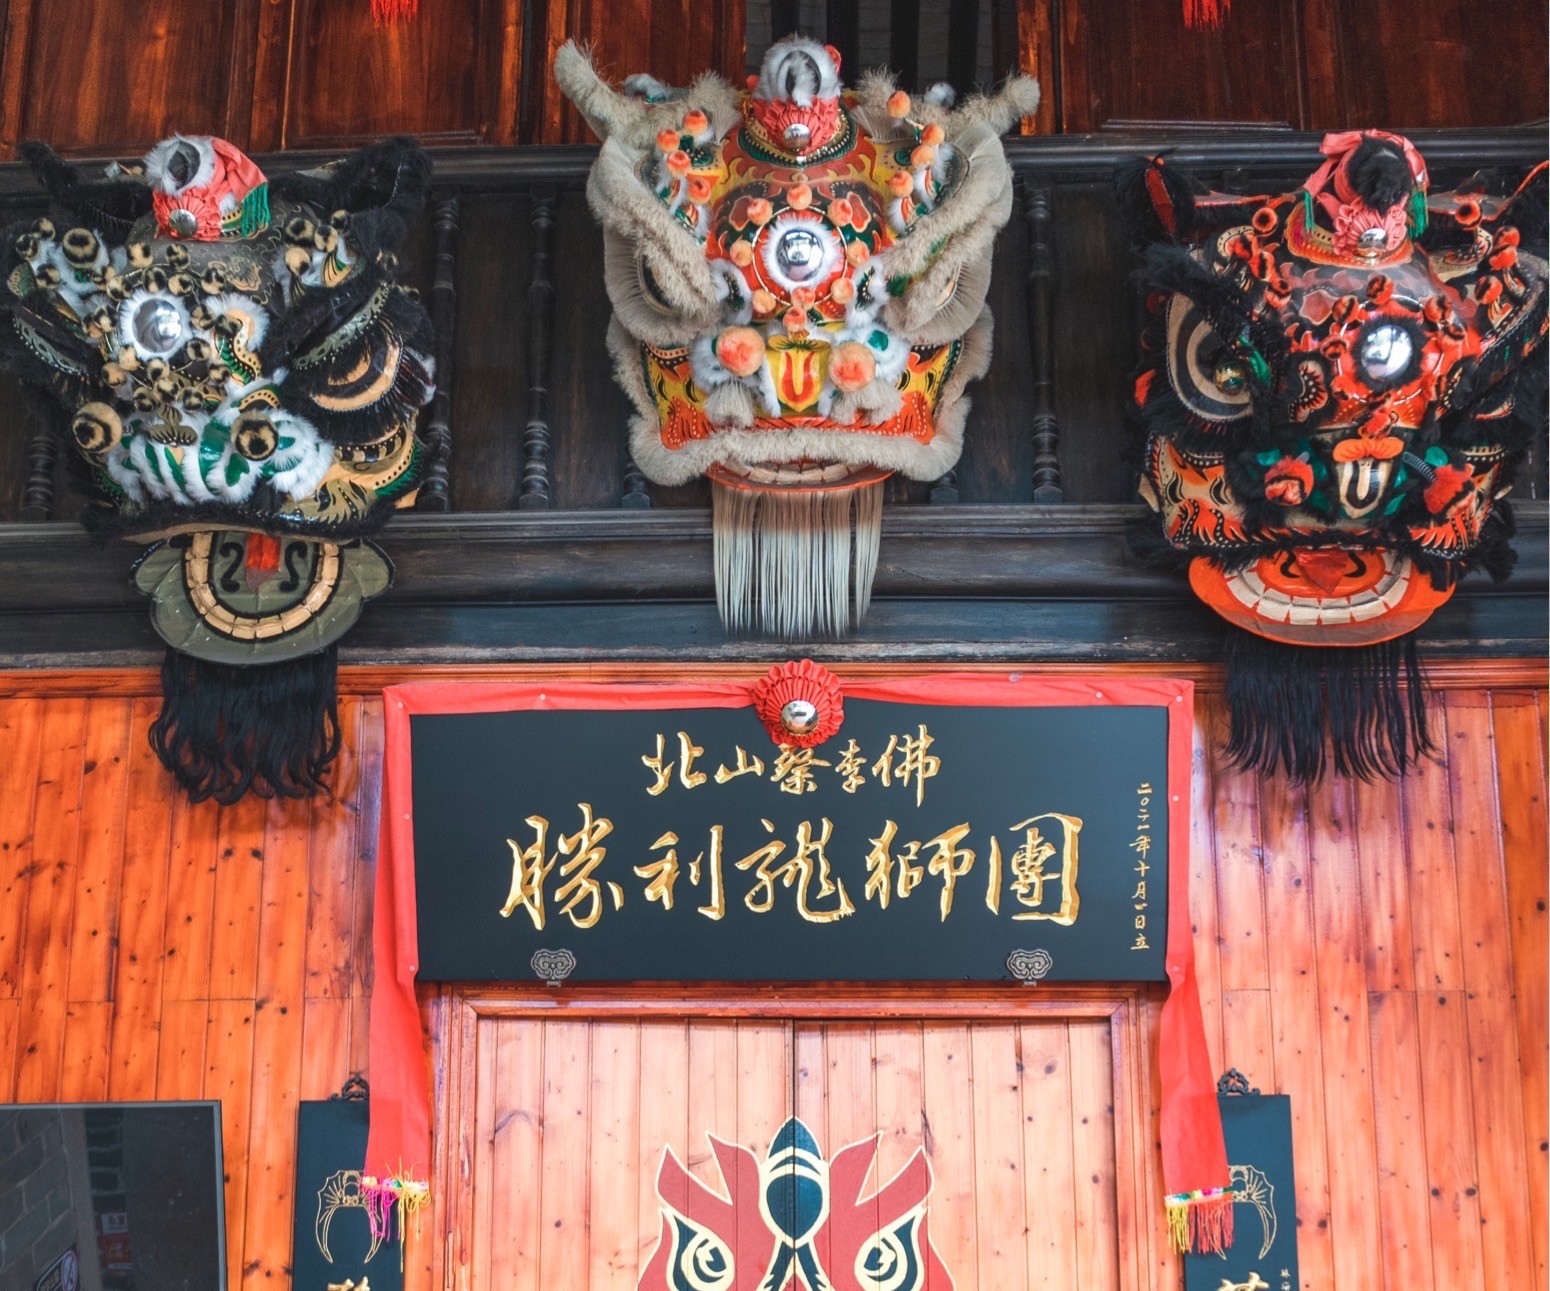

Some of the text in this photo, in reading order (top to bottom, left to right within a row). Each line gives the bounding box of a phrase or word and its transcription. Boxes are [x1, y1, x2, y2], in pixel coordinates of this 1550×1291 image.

[642, 724, 941, 806] 北山蔡李佛
[500, 803, 1083, 931] 勝利龍獅團
